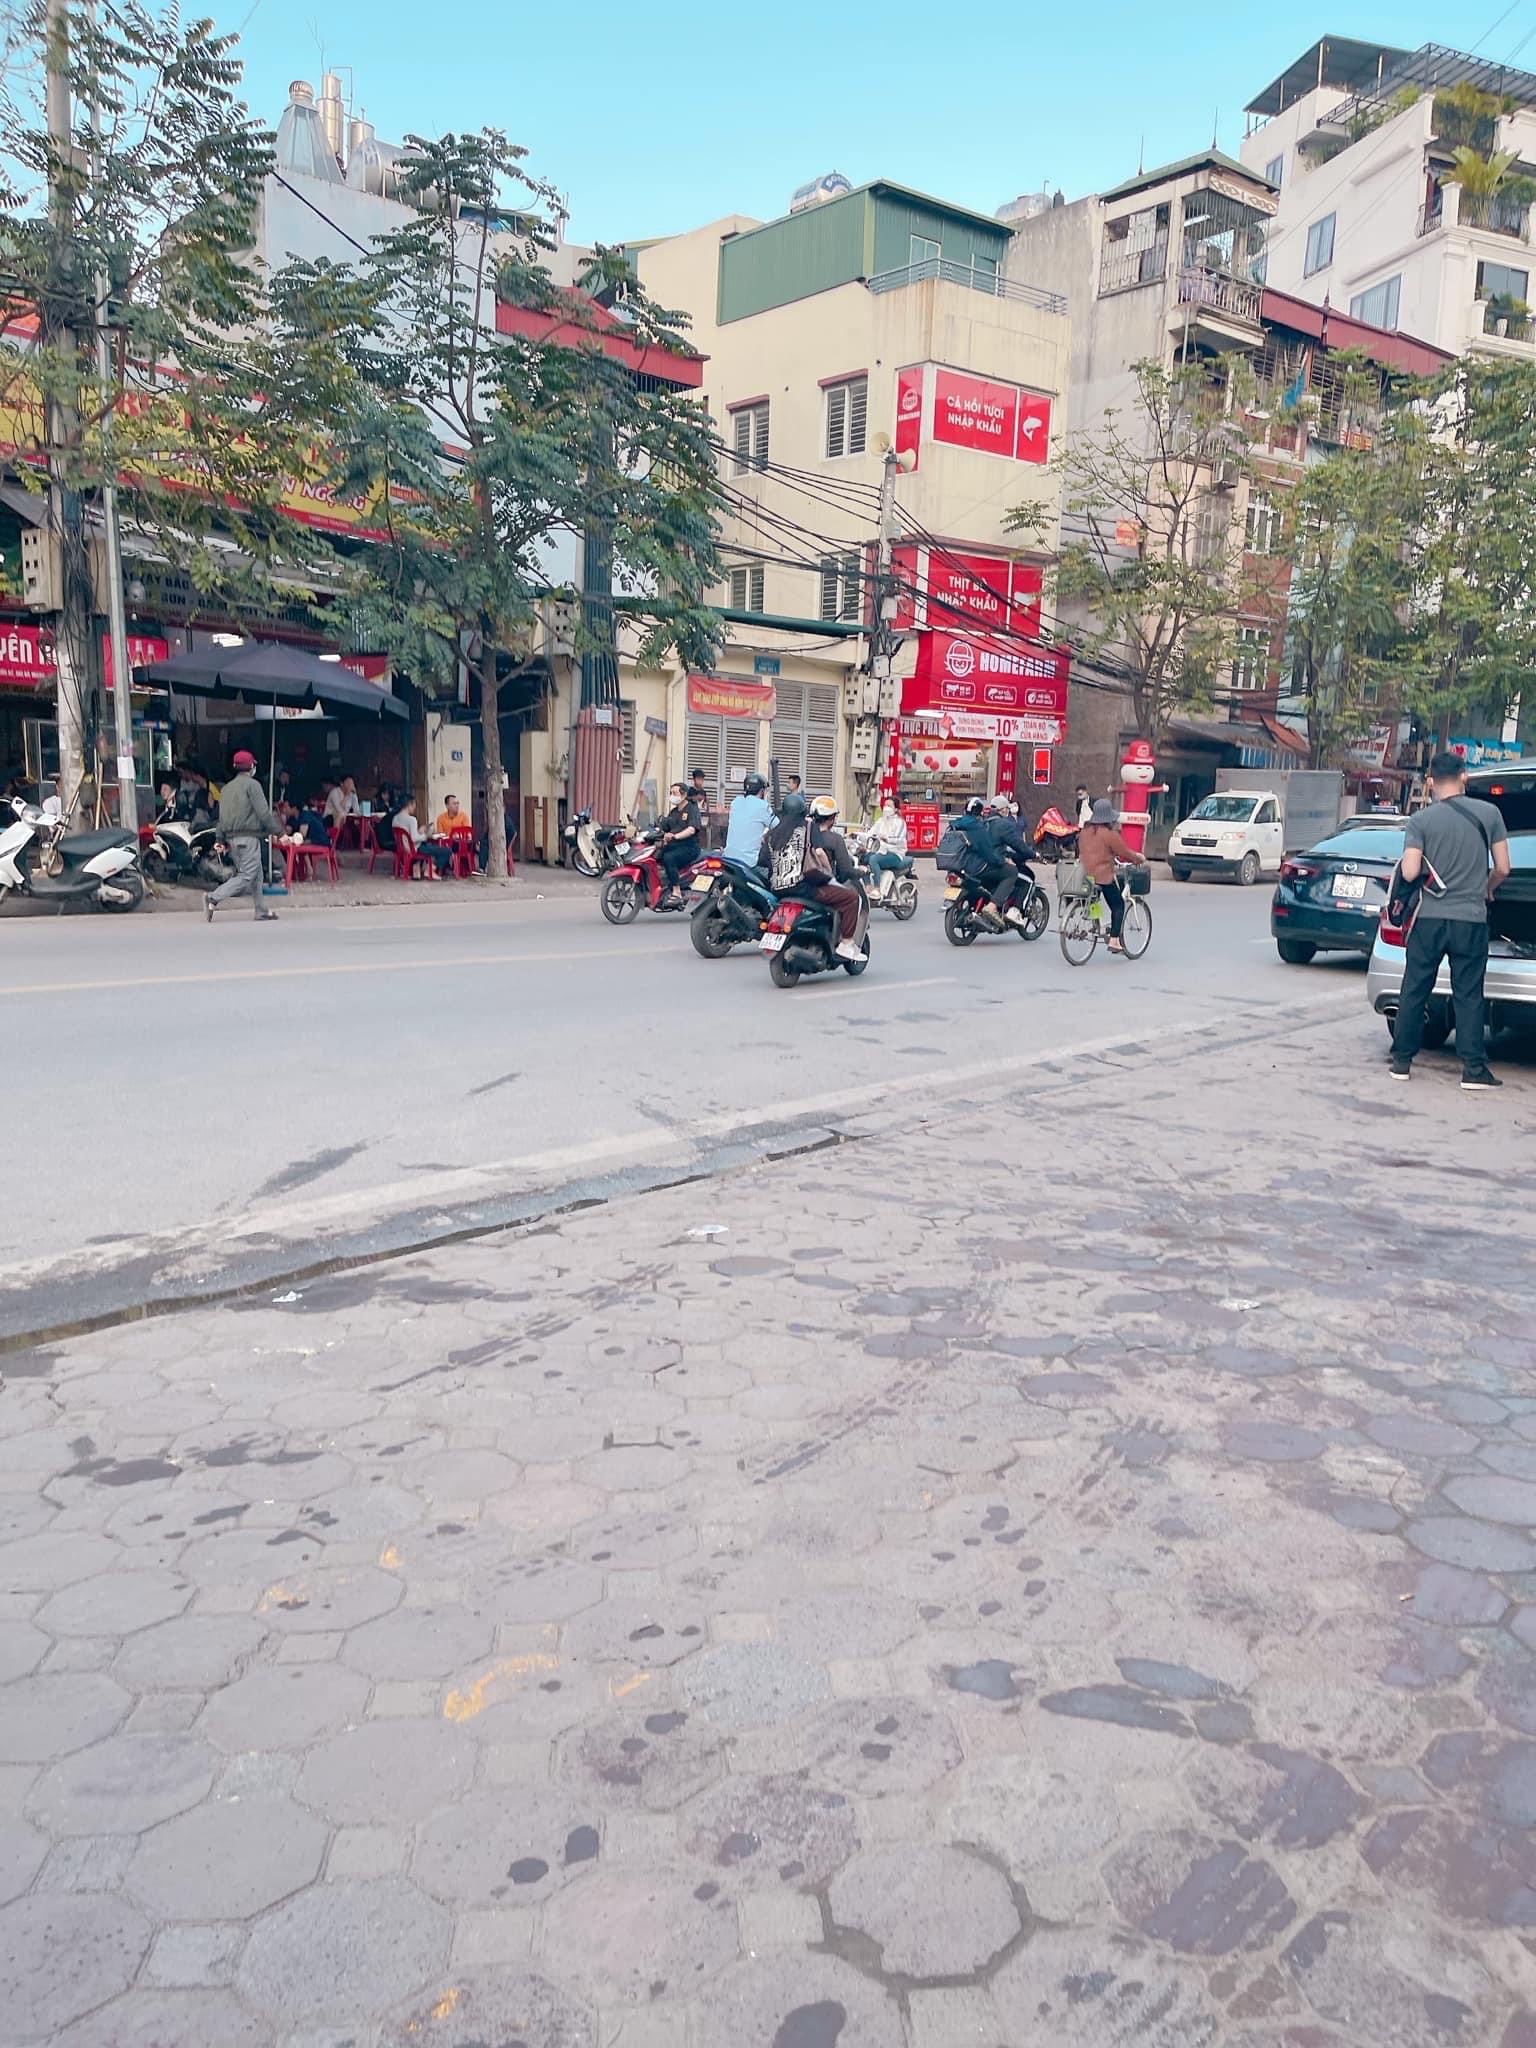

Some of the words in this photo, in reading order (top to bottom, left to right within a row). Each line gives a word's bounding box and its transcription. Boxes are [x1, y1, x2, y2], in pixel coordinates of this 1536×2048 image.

[947, 397, 961, 409] CÁ
[964, 398, 982, 413] HỒI
[984, 404, 1004, 420] TƯƠI
[948, 413, 974, 430] NHẬP
[976, 417, 1002, 434] KHẨU
[949, 575, 970, 593] THỊT
[970, 593, 998, 612] KHẨU
